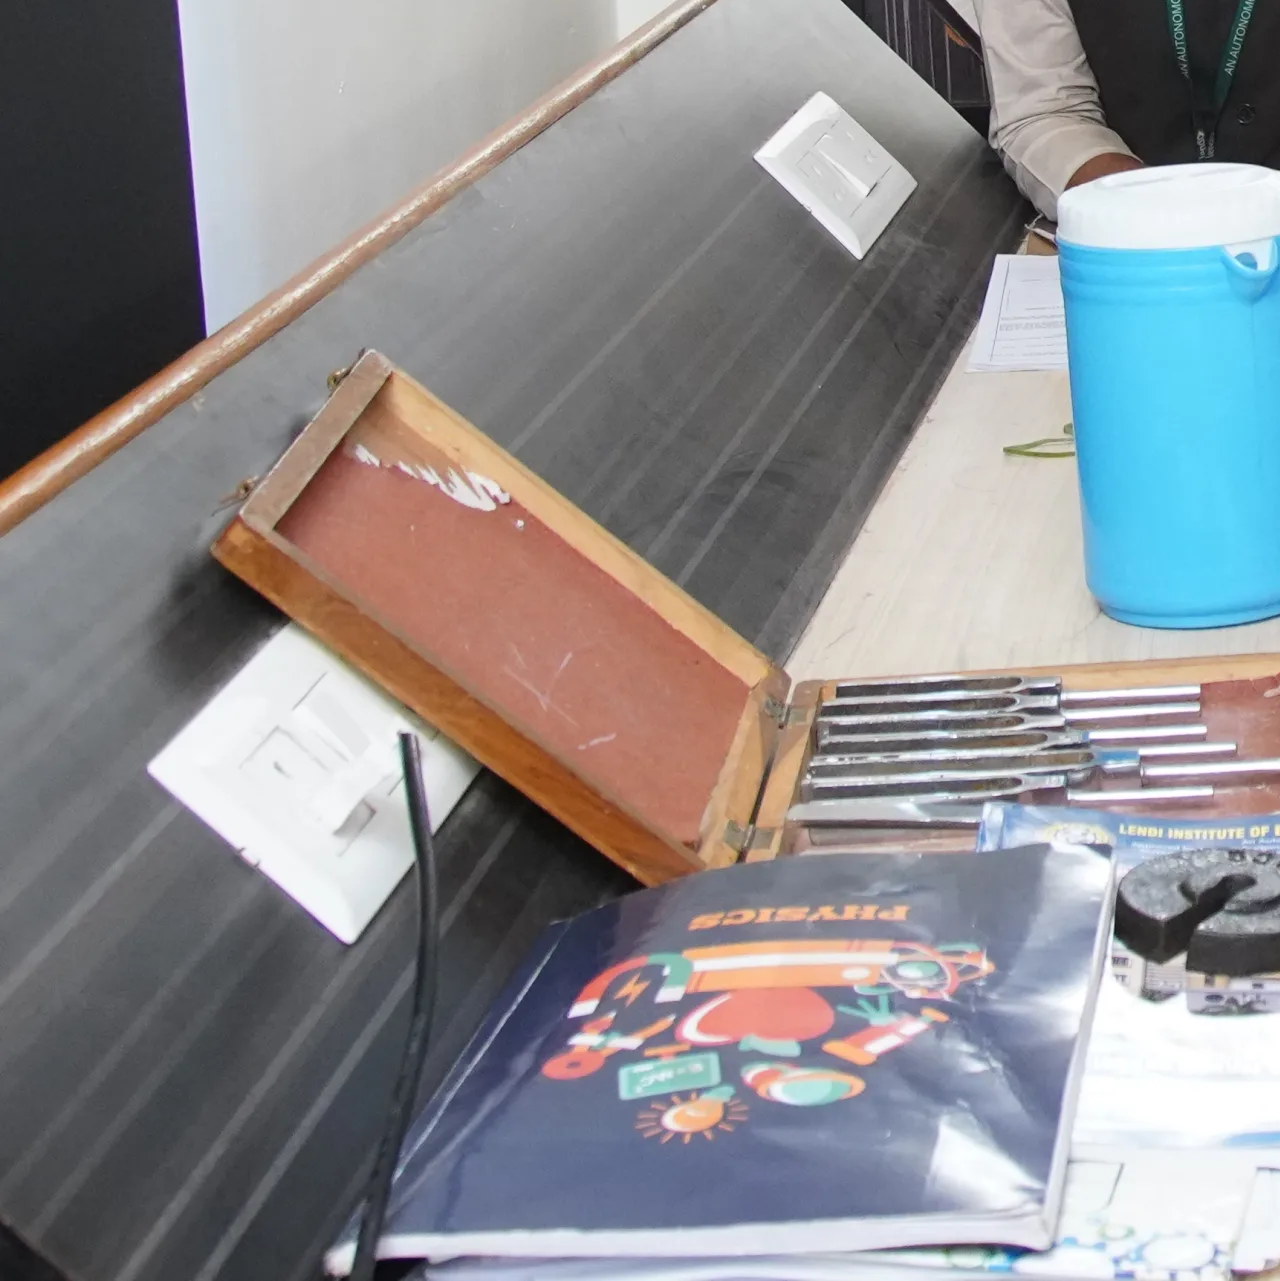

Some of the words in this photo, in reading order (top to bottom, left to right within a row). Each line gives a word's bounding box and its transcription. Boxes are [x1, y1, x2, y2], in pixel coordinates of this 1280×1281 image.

[1223, 58, 1237, 75] AN
[1119, 823, 1162, 838] LENDI
[1168, 825, 1244, 840] INSTITUTE
[1250, 824, 1269, 838] OF
[688, 903, 910, 932] PHYSICS
